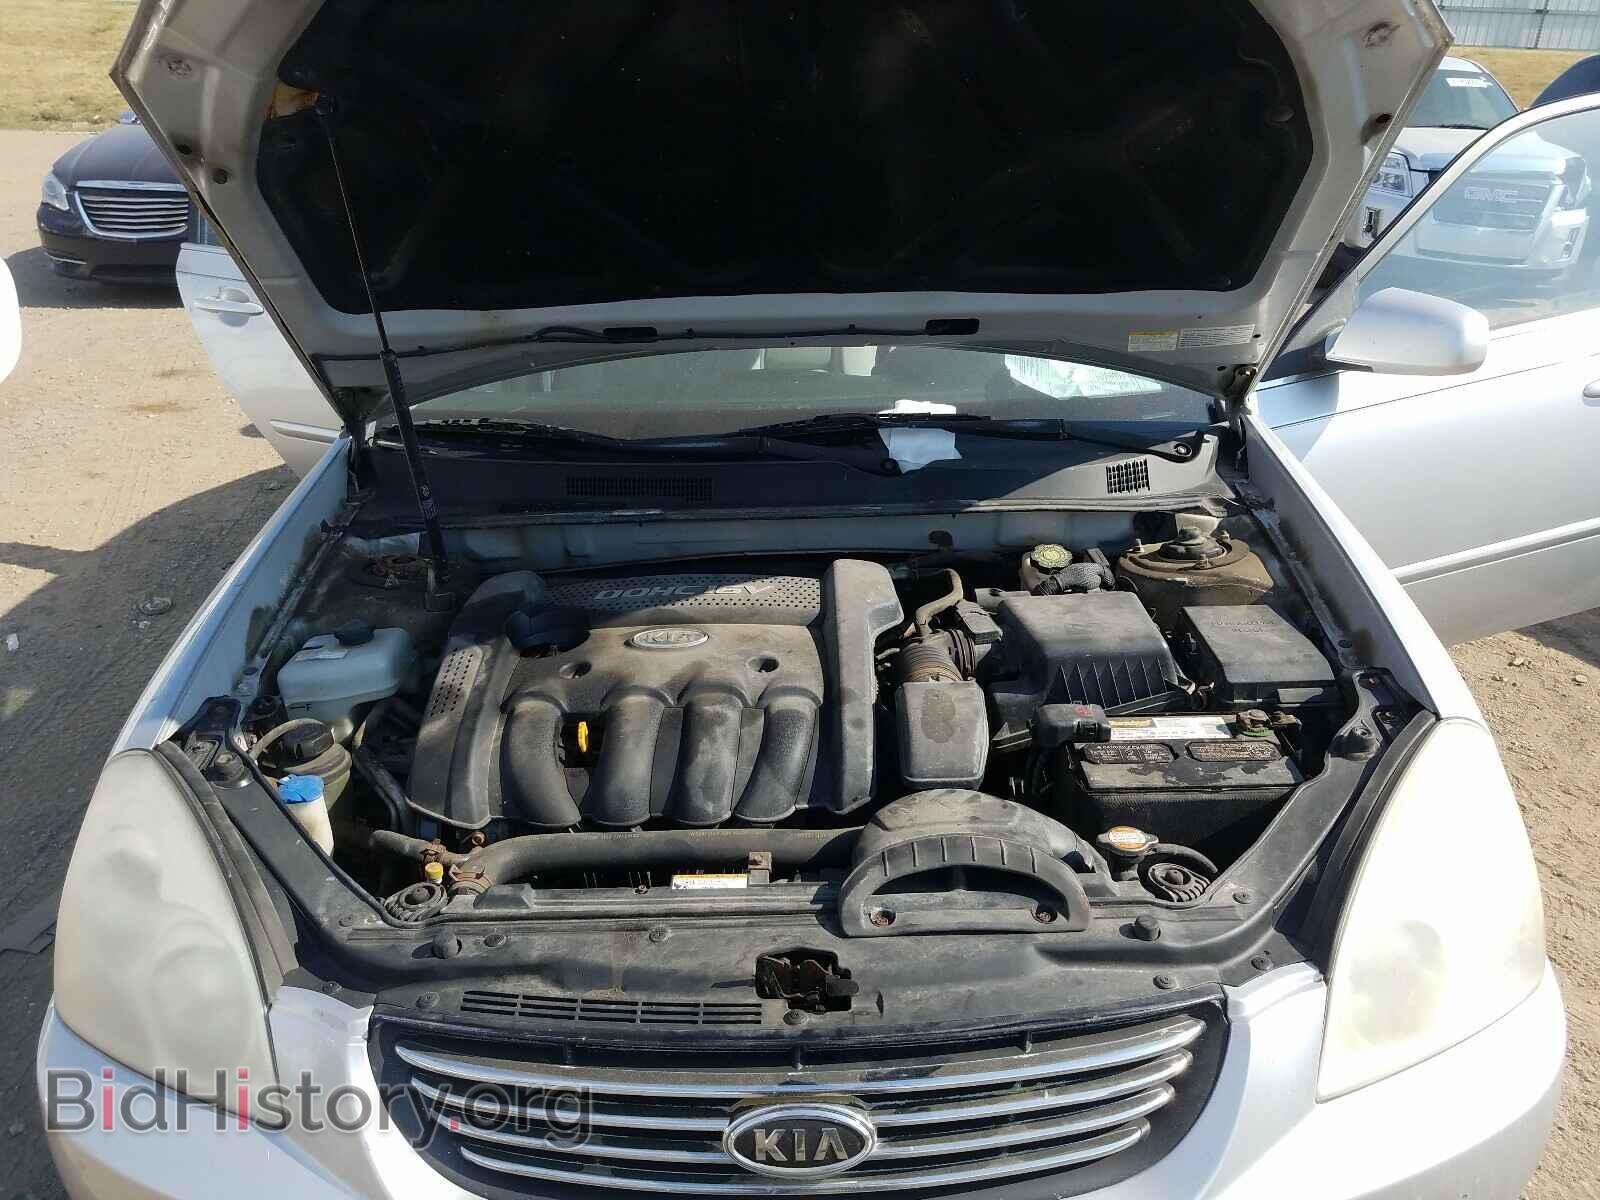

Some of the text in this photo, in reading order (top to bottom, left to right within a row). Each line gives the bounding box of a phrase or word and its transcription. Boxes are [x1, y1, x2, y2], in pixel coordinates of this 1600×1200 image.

[1464, 186, 1518, 203] GMC
[646, 631, 692, 643] KIA
[753, 1127, 848, 1161] KIA
